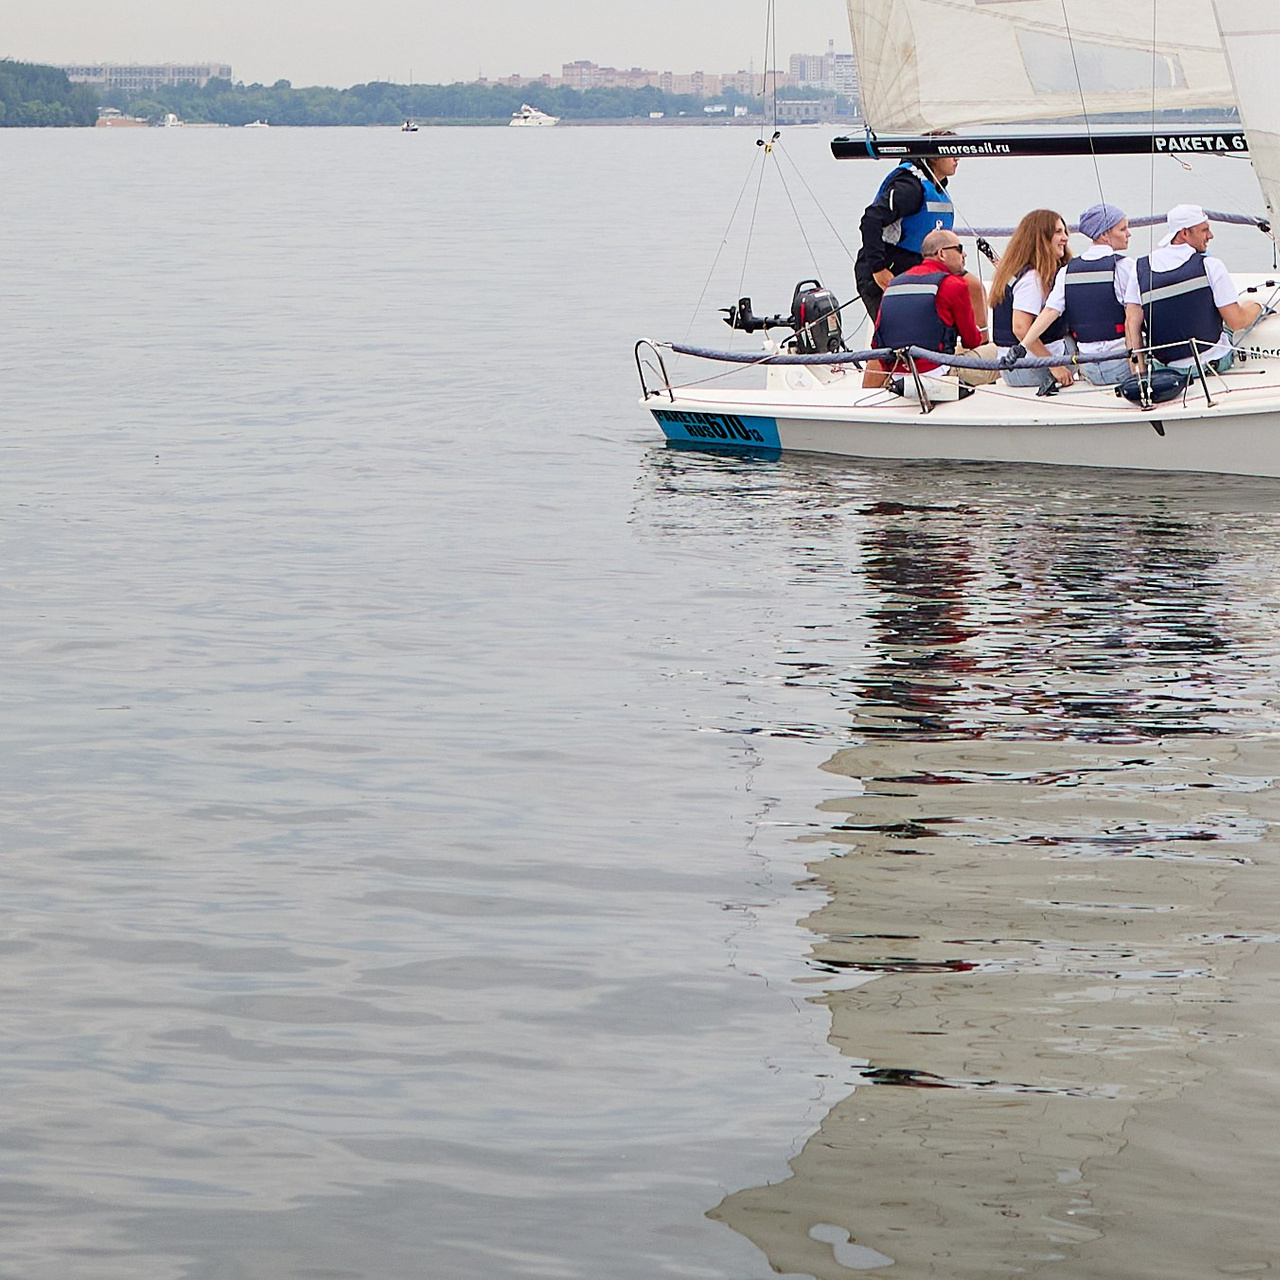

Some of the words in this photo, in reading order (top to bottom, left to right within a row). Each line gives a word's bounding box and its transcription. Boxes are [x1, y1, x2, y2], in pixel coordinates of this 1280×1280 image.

[938, 142, 1011, 155] moresail.ru
[1231, 135, 1248, 151] 6
[684, 424, 716, 439] RUS
